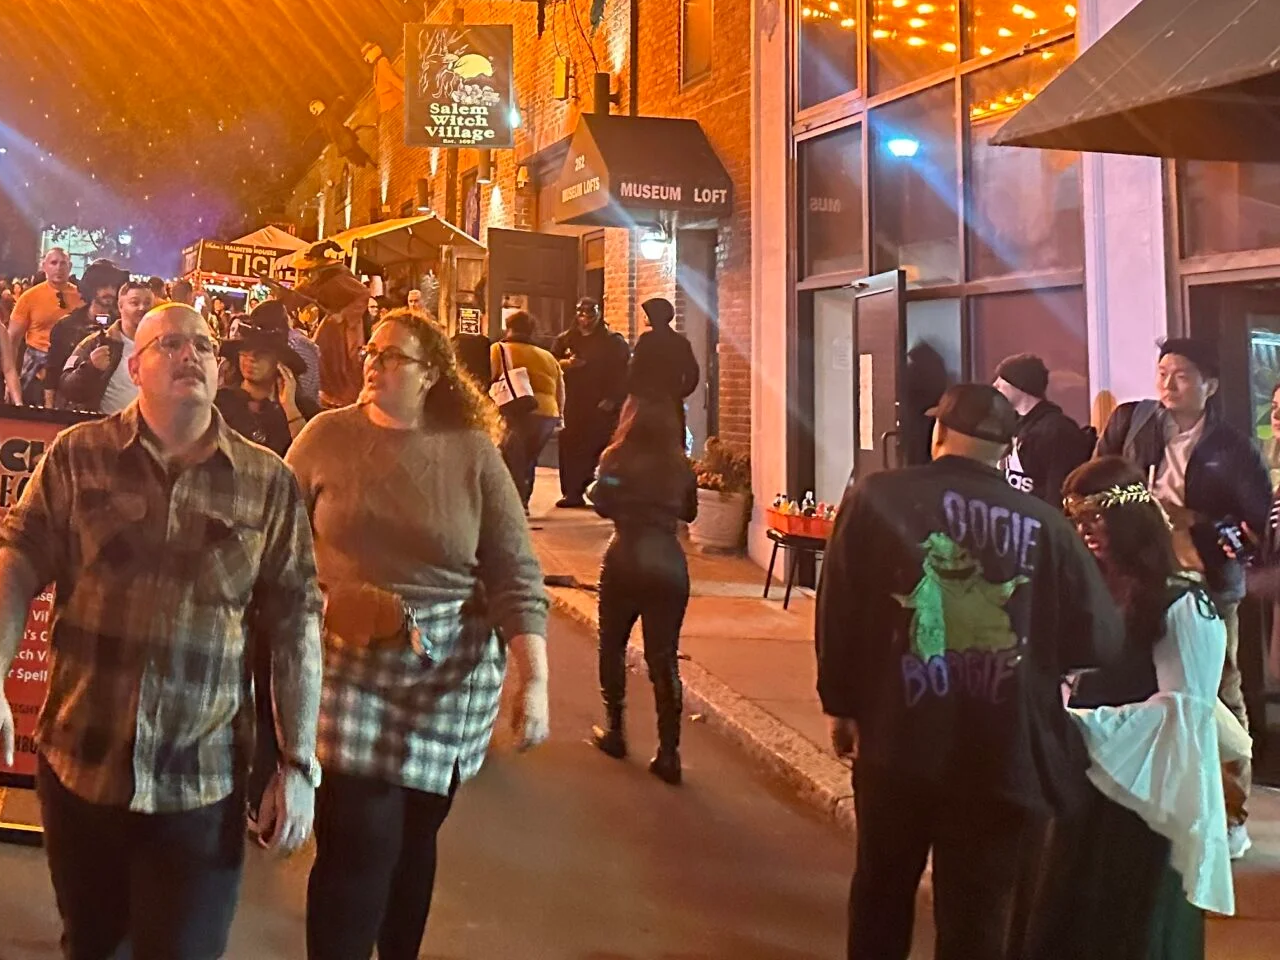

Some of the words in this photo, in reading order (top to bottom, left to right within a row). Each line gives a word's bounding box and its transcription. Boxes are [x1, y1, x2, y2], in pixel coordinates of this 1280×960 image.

[583, 176, 600, 194] LOFTS
[620, 182, 682, 201] MUSEUM
[693, 188, 727, 203] LOFT
[943, 490, 1042, 571] OOGIE
